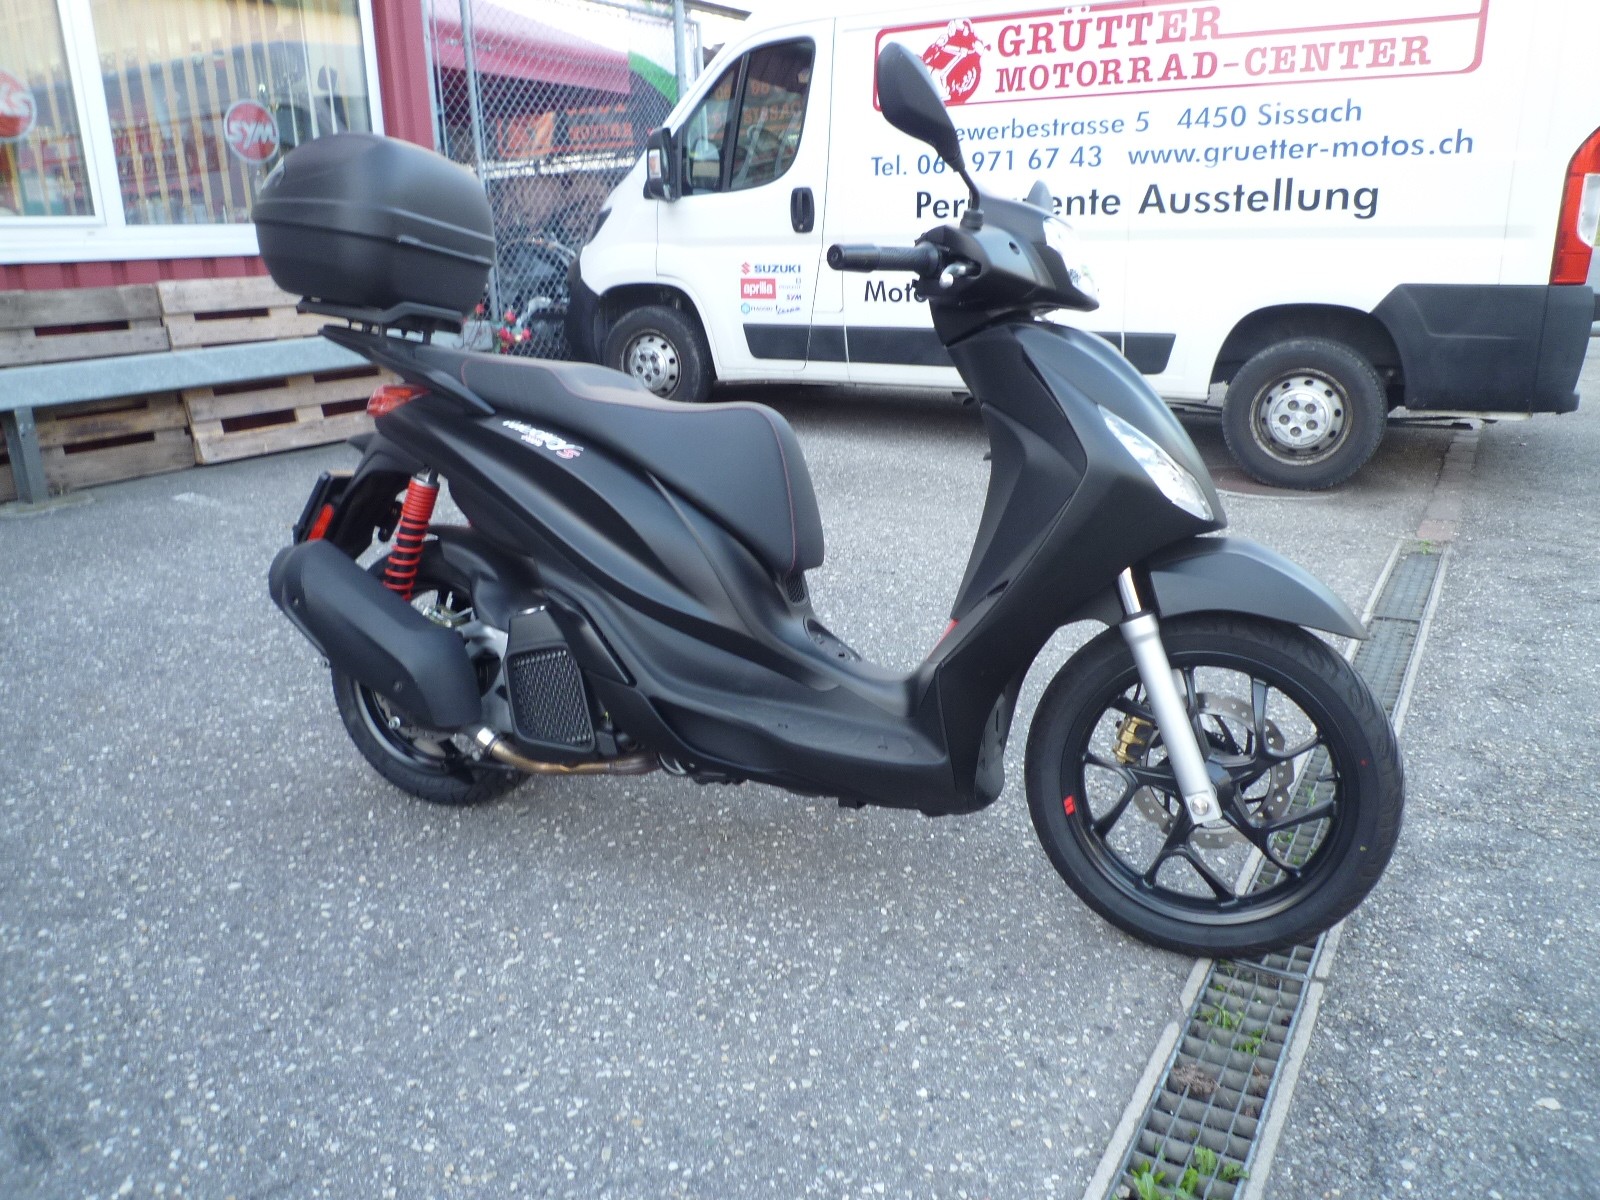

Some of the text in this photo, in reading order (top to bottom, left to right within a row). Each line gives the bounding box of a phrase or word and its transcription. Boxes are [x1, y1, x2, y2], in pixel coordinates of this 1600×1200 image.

[997, 6, 1222, 58] GRÜTTER
[995, 35, 1431, 93] MOTORRAD-CENTER
[228, 120, 274, 150] SYM
[955, 98, 1362, 142] ewerbestrasse 5 4450 Sissach
[871, 128, 1473, 176] Tel. 06 971 67 43 www.gruetter-motos.ch
[1138, 177, 1379, 219] Ausstellung
[743, 280, 773, 297] aprilia
[754, 264, 801, 273] SUZUKI
